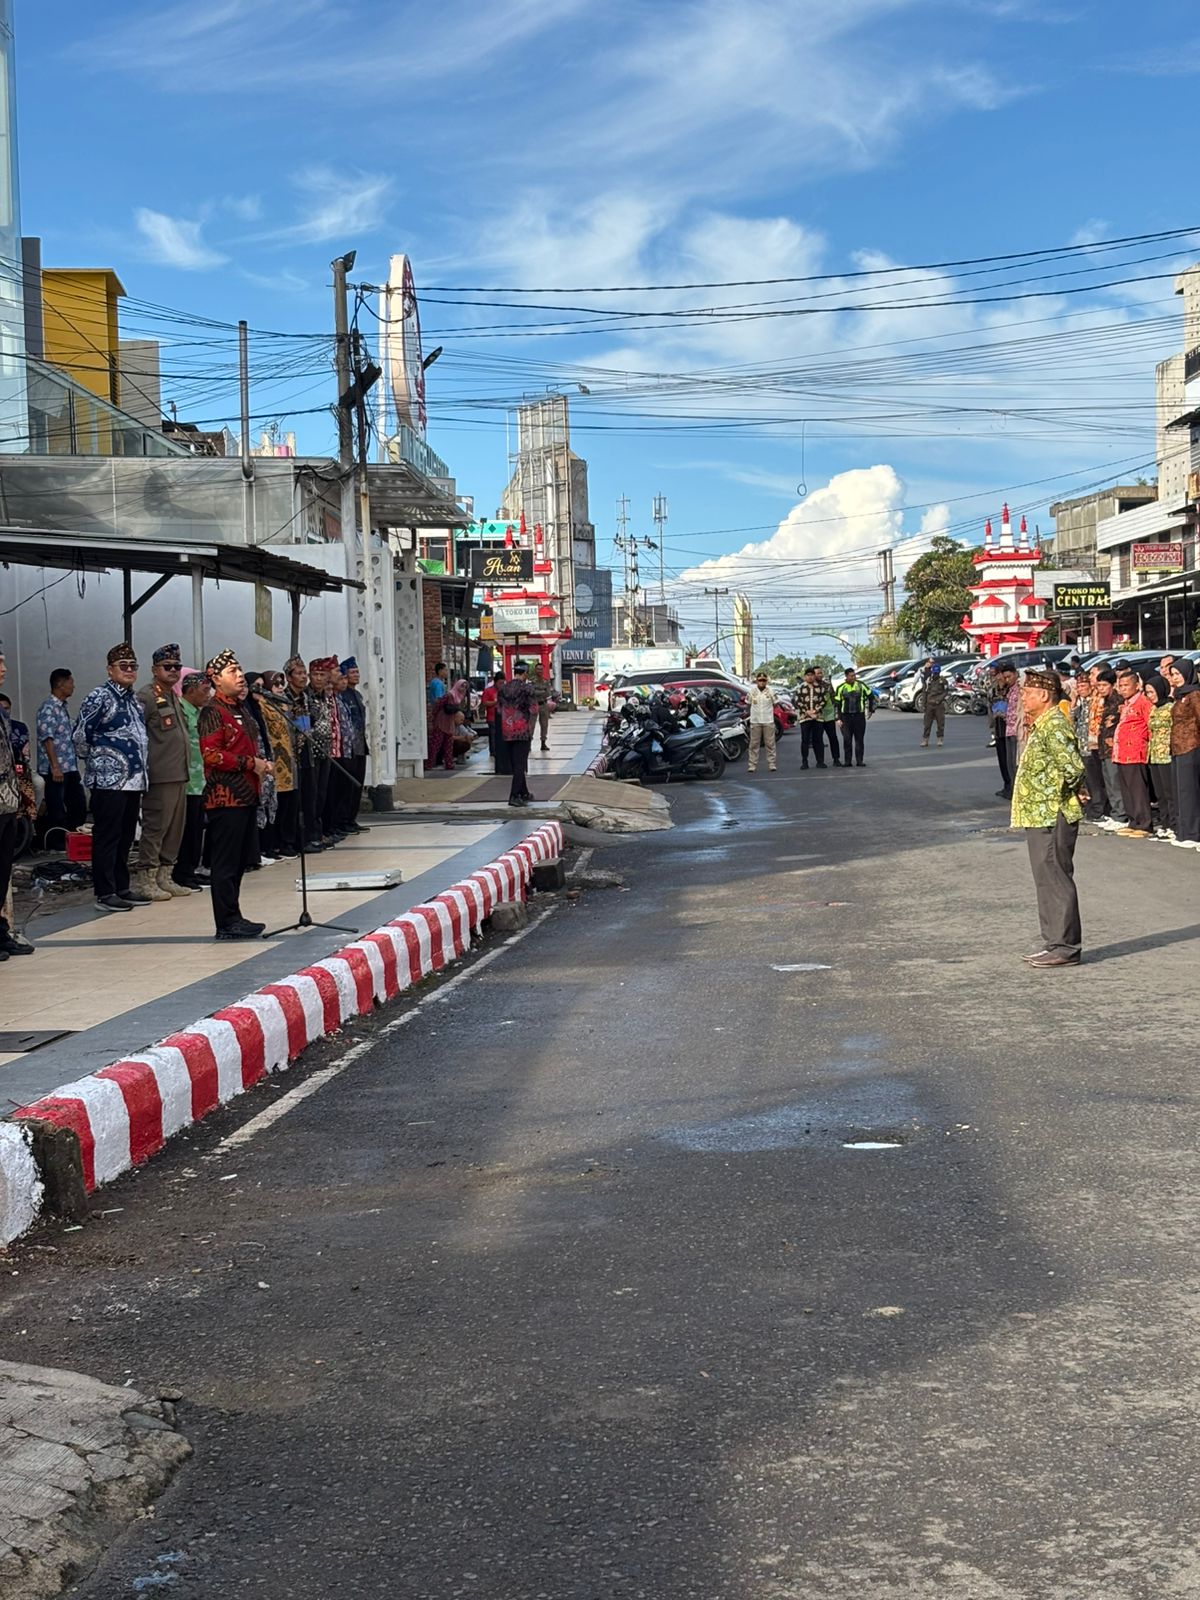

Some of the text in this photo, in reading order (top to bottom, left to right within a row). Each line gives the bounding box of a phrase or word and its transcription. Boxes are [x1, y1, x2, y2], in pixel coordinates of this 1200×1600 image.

[1056, 594, 1111, 607] CENTRAL
[505, 607, 538, 616] TOKO MAS
[562, 649, 584, 661] YENNY
